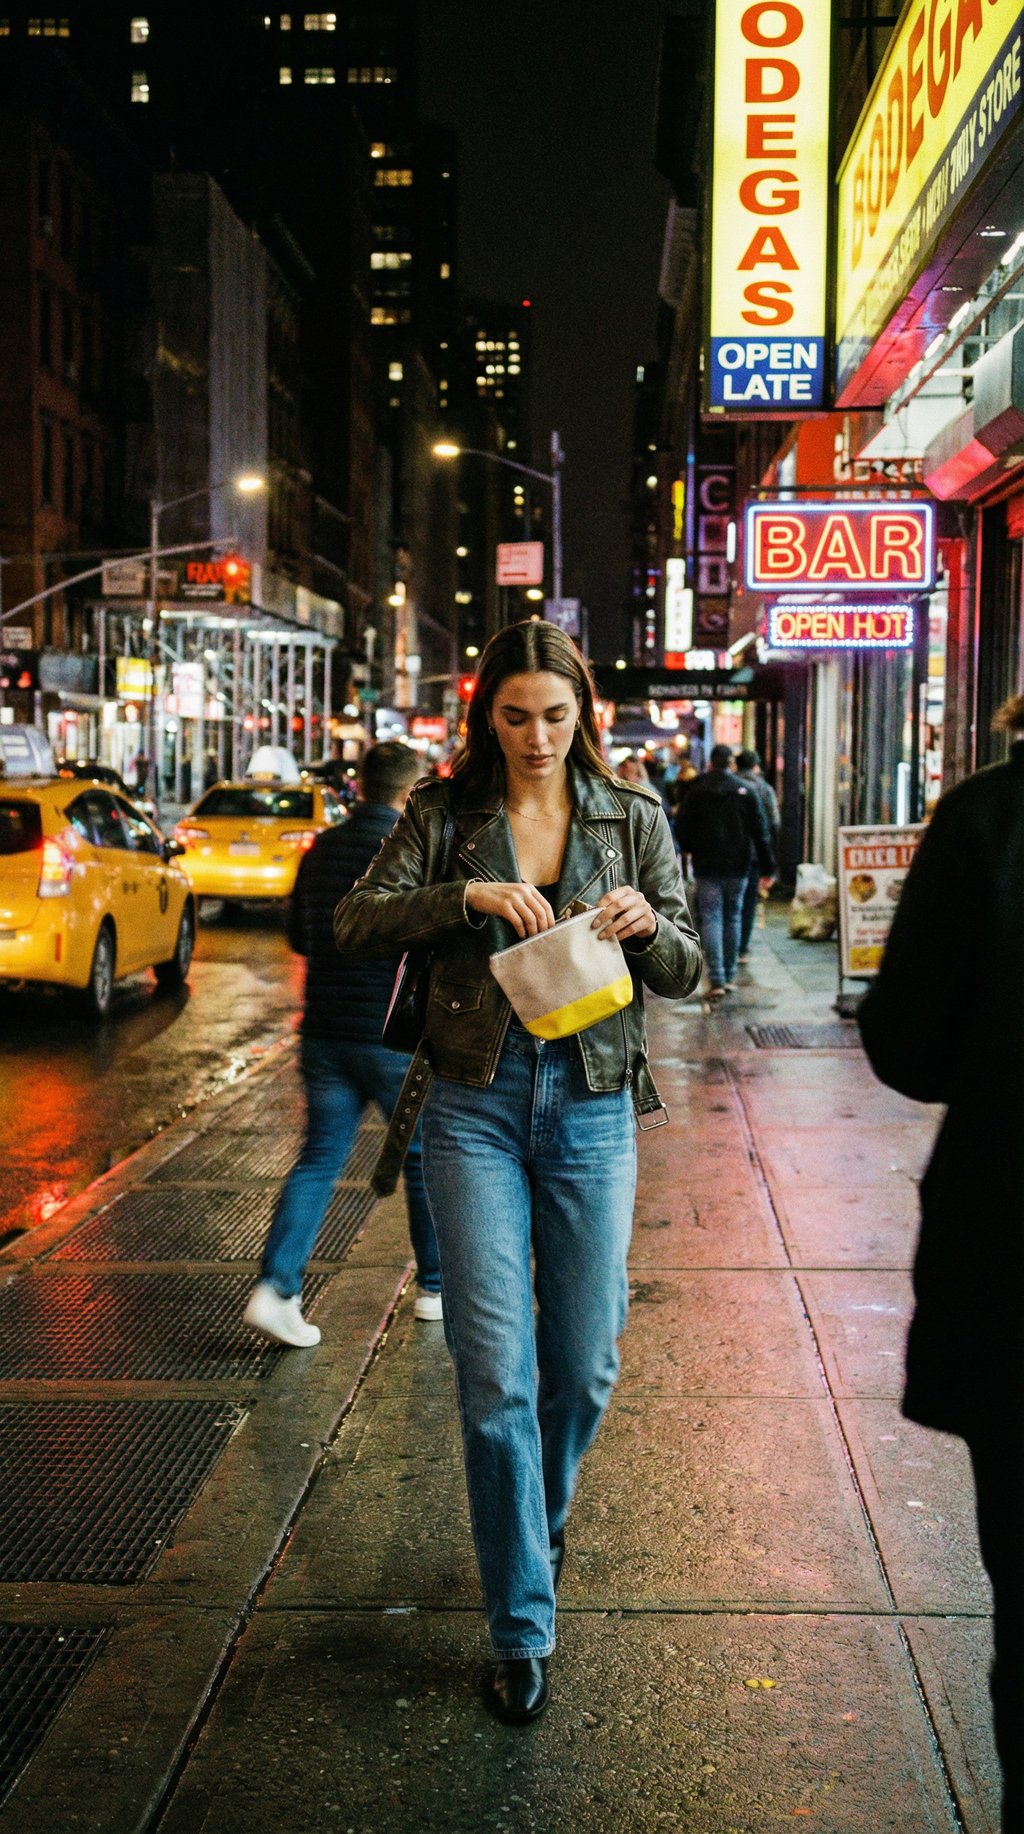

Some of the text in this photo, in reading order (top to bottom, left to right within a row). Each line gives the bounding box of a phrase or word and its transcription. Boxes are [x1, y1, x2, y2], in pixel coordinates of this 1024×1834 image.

[978, 35, 1021, 148] STORE
[852, 0, 998, 272] BODEGA
[718, 343, 817, 369] OPEN
[723, 374, 812, 400] LATE
[755, 515, 923, 579] BAR
[777, 613, 845, 639] OPEN
